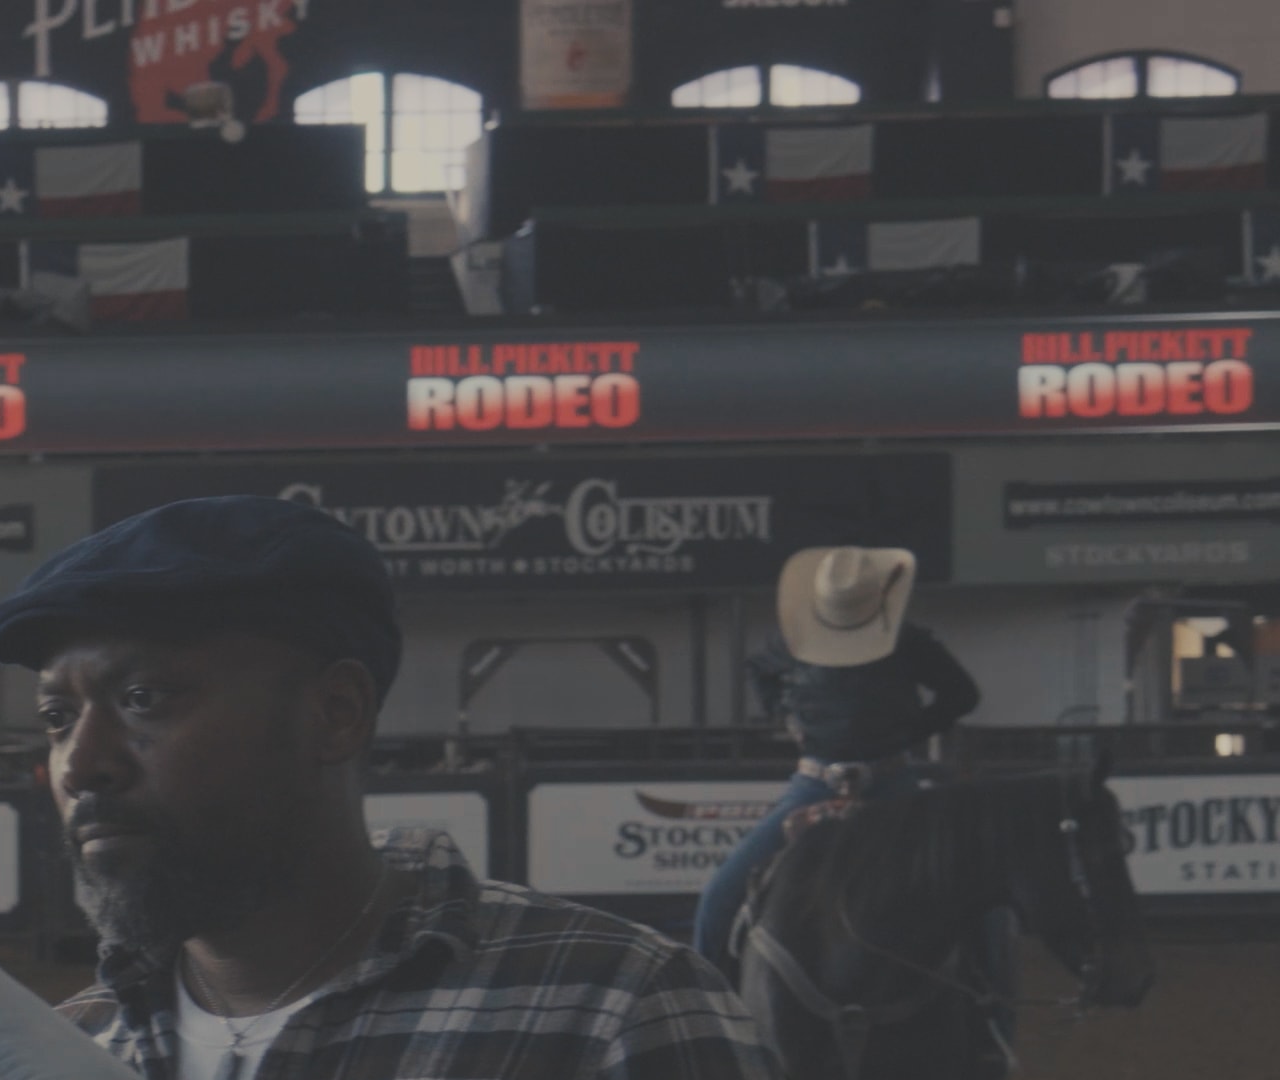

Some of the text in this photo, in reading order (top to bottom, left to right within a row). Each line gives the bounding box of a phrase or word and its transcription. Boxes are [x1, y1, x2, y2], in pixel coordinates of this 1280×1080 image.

[130, 0, 311, 68] WHISKY
[410, 341, 639, 377] BILL PICKETT
[1021, 328, 1253, 364] BILL PICKETT
[407, 372, 640, 430] RODEO
[1018, 358, 1254, 418] RODEO
[564, 477, 773, 556] COLISEUM
[420, 556, 506, 576] WORTH
[533, 553, 696, 574] STOCKYARDS
[1045, 540, 1249, 569] STOCKYARDS
